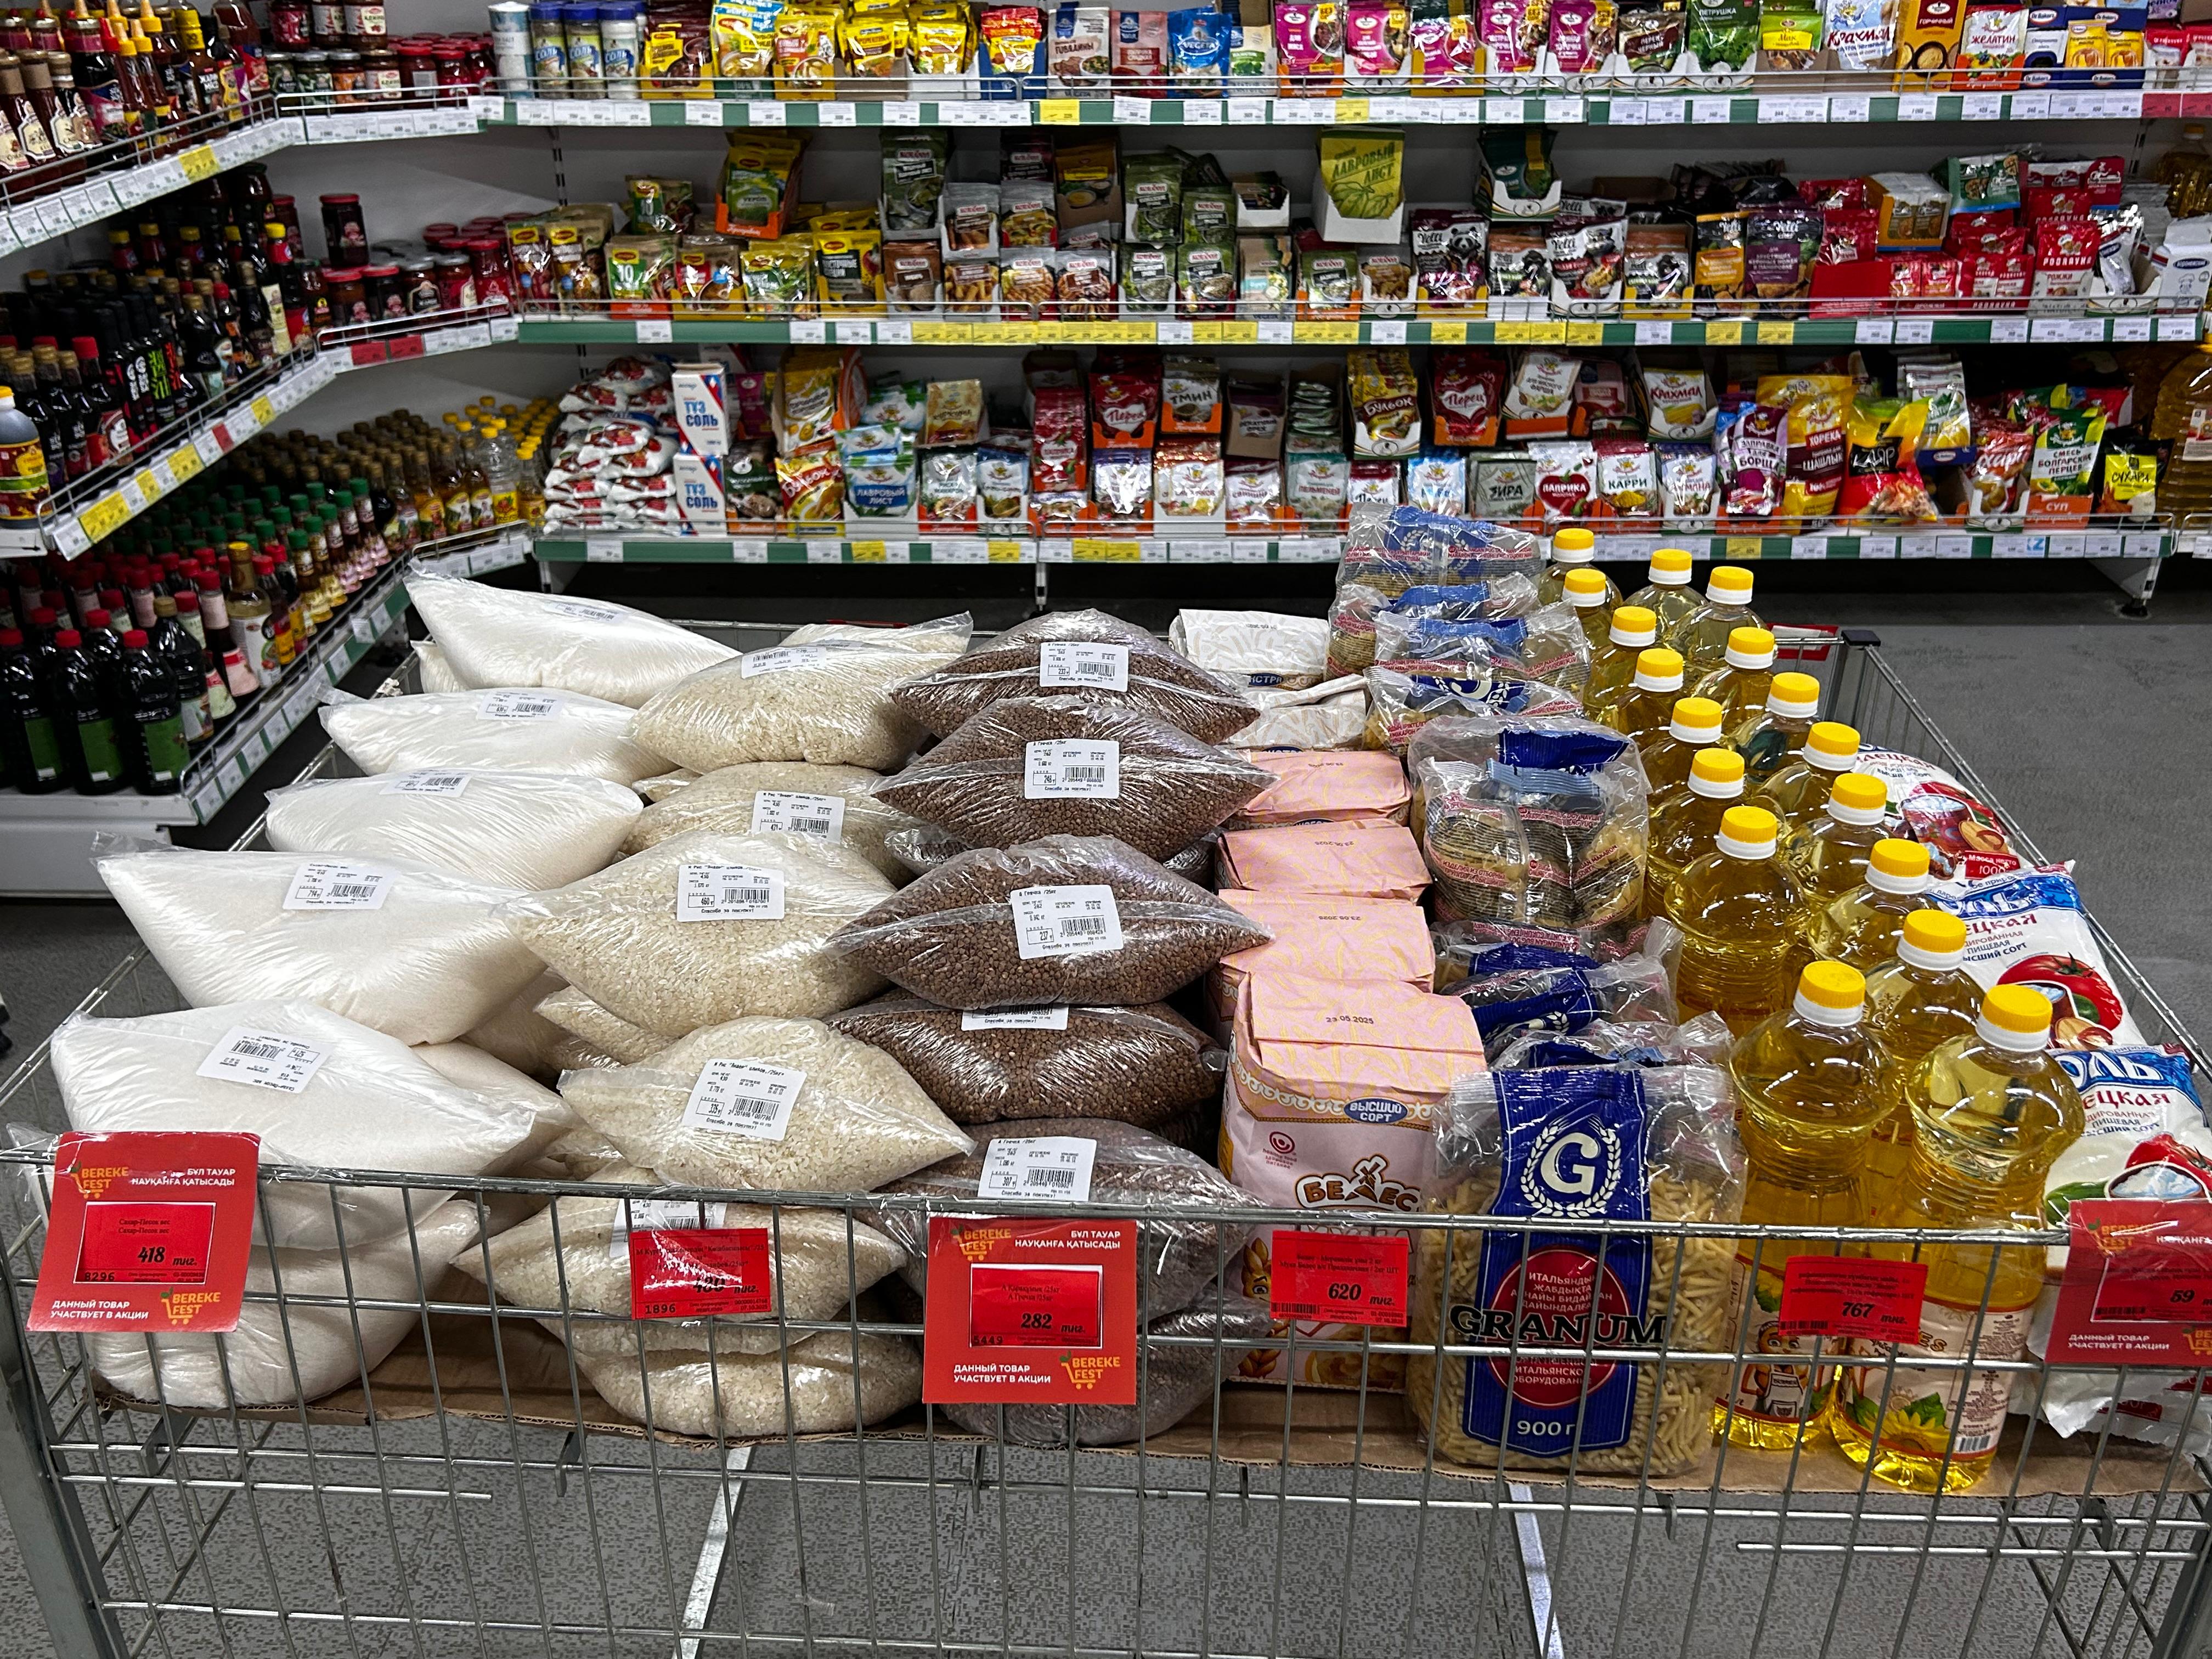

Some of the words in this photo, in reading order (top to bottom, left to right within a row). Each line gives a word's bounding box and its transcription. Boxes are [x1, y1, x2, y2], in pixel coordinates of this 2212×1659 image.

[1699, 8, 1737, 16] ПЕТРУШКА
[1182, 40, 1218, 50] VEGETA
[1971, 33, 2016, 46] ЖЕЛАТИН
[534, 47, 557, 60] СОЛЬ
[569, 46, 592, 59] СОЛЬ
[604, 49, 627, 63] СОЛЬ
[1333, 142, 1395, 178] ЛАВРОВЫЙ
[1364, 164, 1394, 184] ЛИСТ
[1418, 233, 1442, 244] Yelli
[1551, 237, 1576, 250] Yelli
[2043, 256, 2092, 267] PODRAVKA
[618, 264, 634, 283] 10
[1170, 390, 1212, 405] ТМИН
[685, 401, 706, 415] ТУЗ
[686, 414, 718, 428] СОЛЬ
[1809, 431, 1841, 446] ХОРЕКА
[2053, 448, 2081, 458] СМЕСЬ
[1802, 450, 1844, 471] ШАШЛЫК
[2048, 463, 2082, 475] ПЕРЦЕВ
[1543, 482, 1586, 493] ПАПРИКА
[1608, 478, 1647, 489] КАРРИ
[685, 483, 706, 498] ТУЗ
[856, 487, 905, 499] ЛАВРОВЫЙ
[1488, 486, 1523, 498] ЗИРА
[686, 496, 718, 510] СОЛЬ
[868, 496, 893, 505] ЛИСТ
[2046, 501, 2068, 512] СУП
[1964, 913, 2038, 937] ЕЦКАЯ
[1040, 931, 1048, 941] 237
[1965, 930, 2024, 947] ДИРОВАННАЯ
[1966, 939, 2011, 954] ПИЩЕВАЯ
[1962, 949, 2001, 963] ЫСШИЙ
[2003, 943, 2028, 955] СОРТ
[2056, 1052, 2164, 1090] ОЛЬ
[2083, 1091, 2171, 1109] ЕЦКАЯ
[1348, 1100, 1403, 1115] ВЫСШИЙ
[1359, 1112, 1392, 1124] СОРТ
[2091, 1118, 2141, 1128] ПИЩЕВАЯ
[1541, 1132, 1600, 1195] G
[82, 1166, 129, 1178] BEREKE
[207, 1168, 236, 1176] ТАУАР
[83, 1179, 112, 1189] FEST
[1304, 1180, 1421, 1211] БЕЛЕС
[964, 1228, 1011, 1240] BEREKE
[1091, 1231, 1121, 1239] ТАУАР
[966, 1240, 994, 1250] FEST
[137, 1246, 165, 1263] 418
[84, 1272, 115, 1283] 8296
[172, 1292, 221, 1304] BEREKE
[1328, 1283, 1362, 1301] 620
[1510, 1289, 1556, 1303] АНАЙЫ
[53, 1300, 96, 1310] ДАННЫЙ
[98, 1301, 130, 1310] ТОВАР
[173, 1304, 202, 1315] FEST
[645, 1303, 676, 1314] 1896
[1841, 1301, 1875, 1318] 767
[50, 1310, 104, 1319] УЧАСТВУЕТ
[114, 1311, 149, 1320] АКЦИИ
[1020, 1312, 1052, 1329] 282
[1448, 1304, 1668, 1345] GRANUM
[1071, 1356, 1120, 1368] BEREKE
[953, 1363, 997, 1374] ДАННЫЙ
[999, 1364, 1030, 1373] ТОВАР
[1074, 1368, 1104, 1379] FEST
[1516, 1365, 1587, 1376] ИТАЛЬЯНСКО
[953, 1374, 1006, 1384] УЧАСТВУЕТ
[1018, 1375, 1051, 1384] АКЦИИ
[1517, 1421, 1562, 1436] 900
[1566, 1423, 1576, 1435] г
